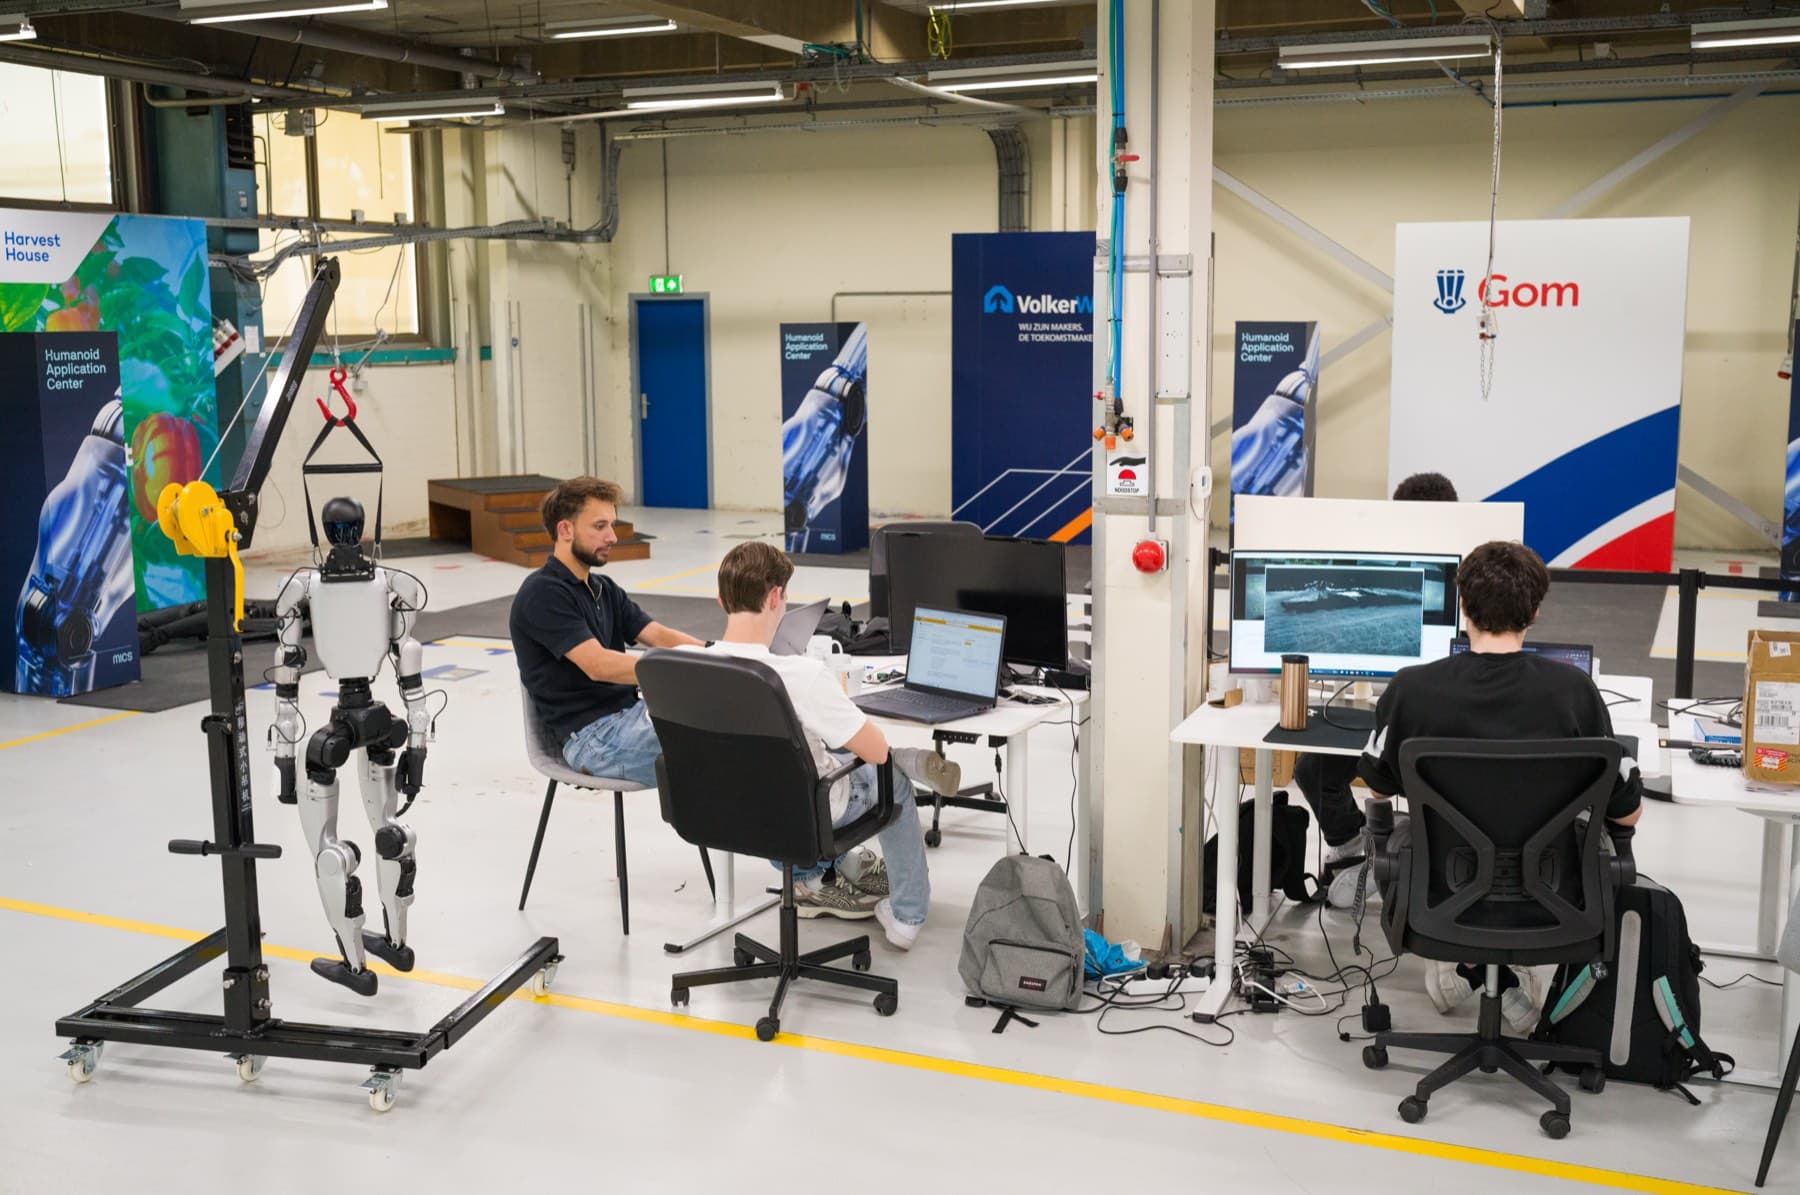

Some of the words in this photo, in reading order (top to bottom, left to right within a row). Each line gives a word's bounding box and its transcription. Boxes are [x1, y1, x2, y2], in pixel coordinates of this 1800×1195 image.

[4, 231, 61, 247] Harvest
[6, 247, 50, 262] House
[1478, 274, 1580, 308] Gom
[784, 333, 824, 342] Humanoid
[1018, 333, 1030, 342] DE
[1241, 332, 1289, 342] Humanoid
[785, 342, 828, 351] Application
[1241, 342, 1294, 353] Application
[45, 348, 100, 361] Humanoid
[785, 352, 811, 360] Center
[1240, 352, 1272, 362] Center
[46, 363, 107, 378] Application
[47, 378, 84, 390] Center
